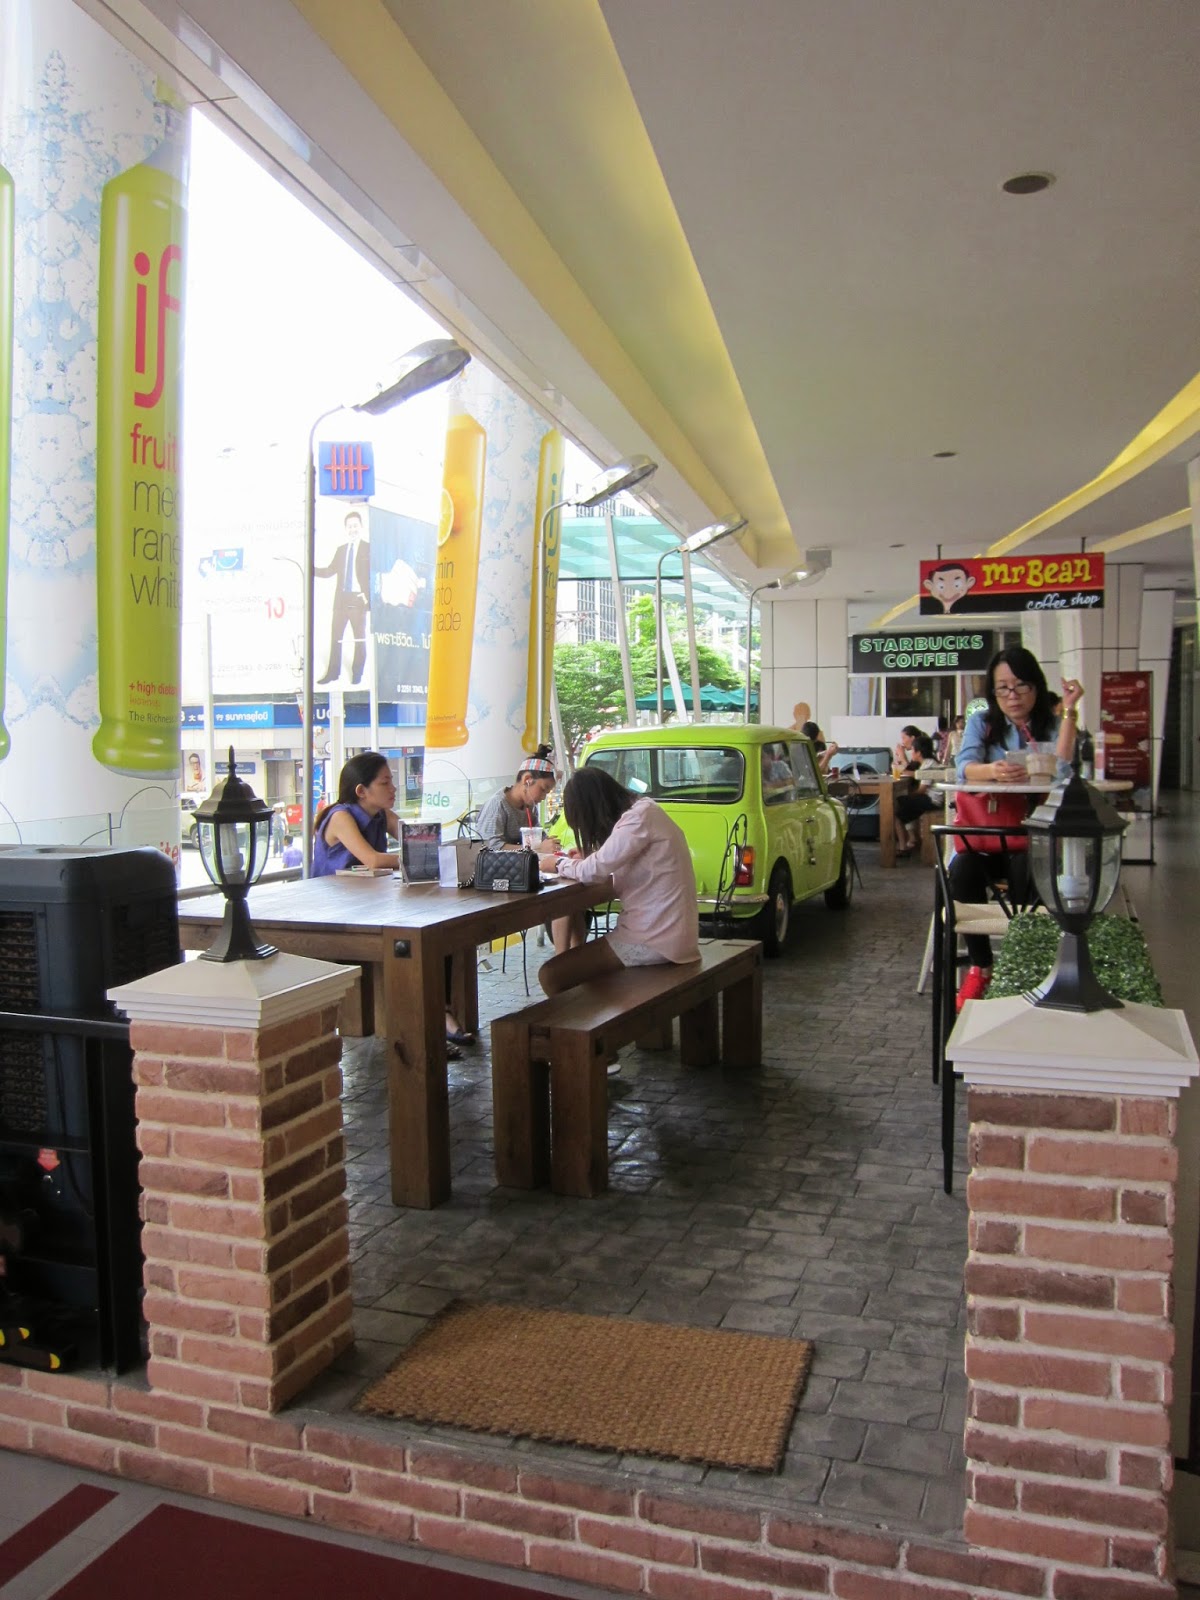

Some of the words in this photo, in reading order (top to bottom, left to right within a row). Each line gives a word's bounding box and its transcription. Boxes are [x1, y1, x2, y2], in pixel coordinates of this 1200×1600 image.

[133, 244, 182, 409] if
[130, 422, 179, 473] fruit
[1026, 592, 1069, 611] coffee
[1071, 592, 1101, 609] shop
[859, 634, 984, 653] STARBUCKS
[883, 652, 959, 669] COFFEE
[128, 710, 145, 722] The
